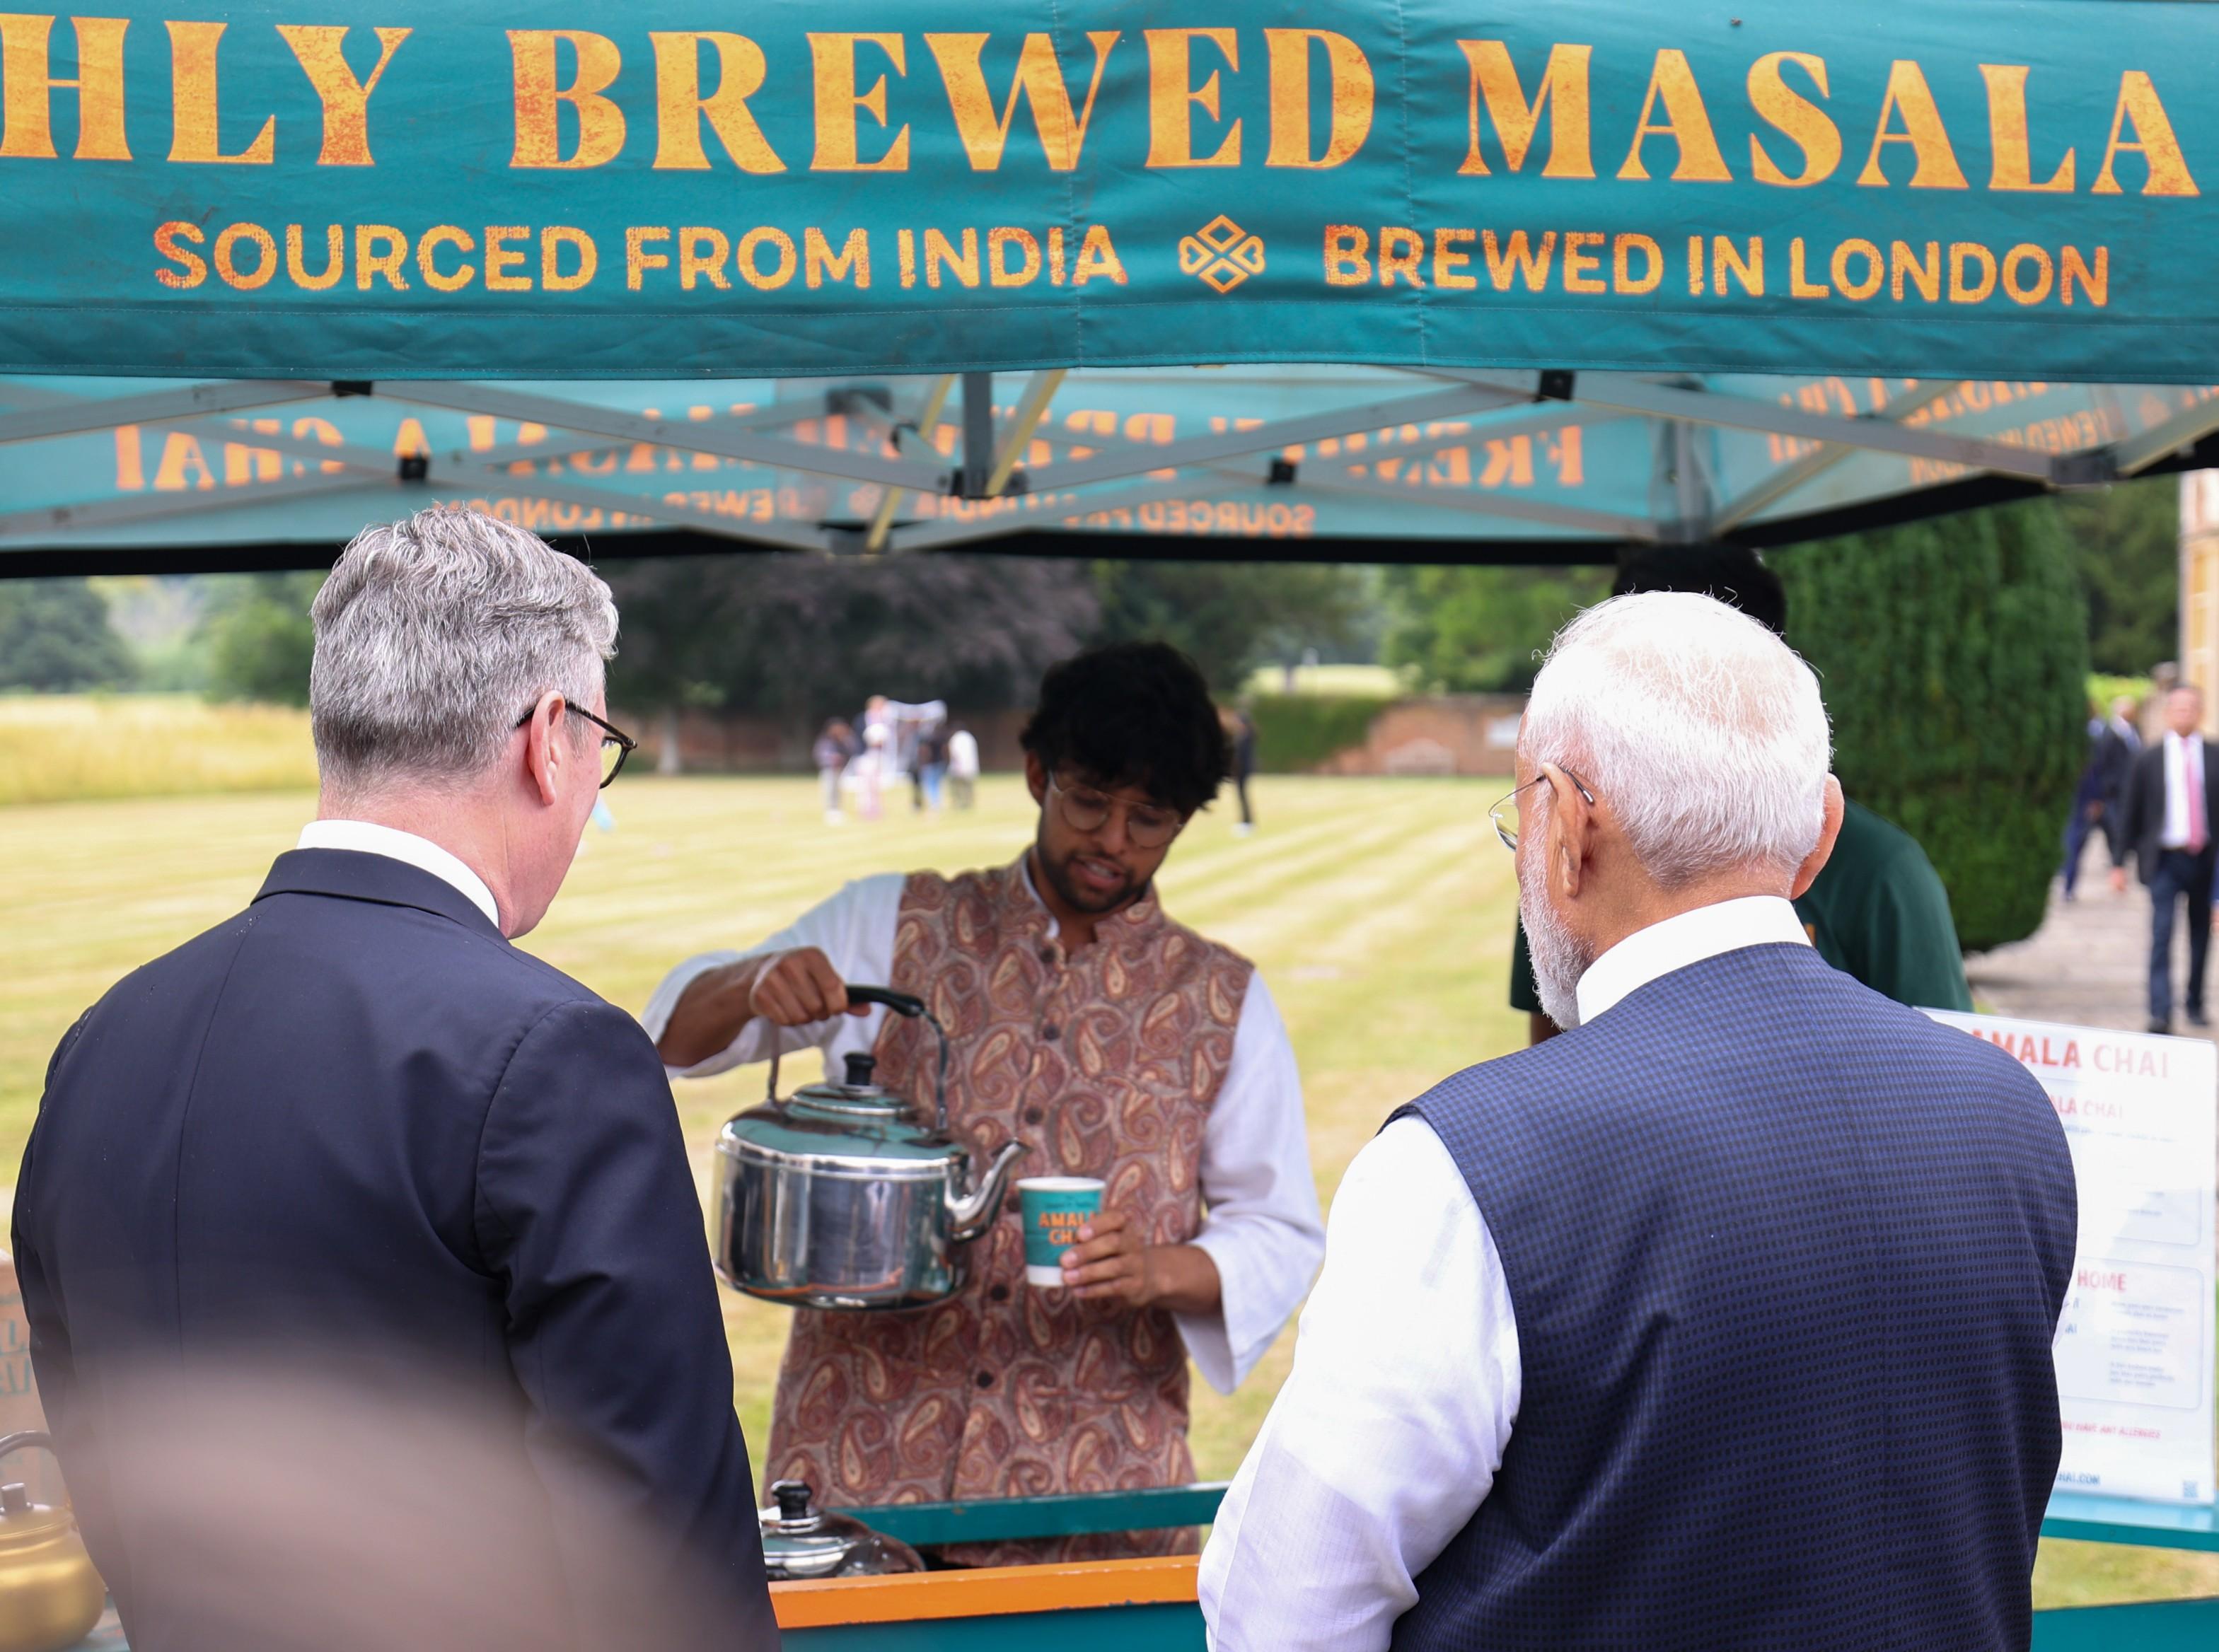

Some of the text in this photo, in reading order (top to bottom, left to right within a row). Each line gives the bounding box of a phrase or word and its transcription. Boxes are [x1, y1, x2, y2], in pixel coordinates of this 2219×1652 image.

[0, 13, 2201, 197] HLY BREWED MASALA
[153, 221, 1129, 292] SOURCED FROM INDIA
[1323, 223, 2109, 307] BREWED IN LONDON
[1971, 1028, 2169, 1079] MALA CHAI
[2077, 1270, 2128, 1293] HOME
